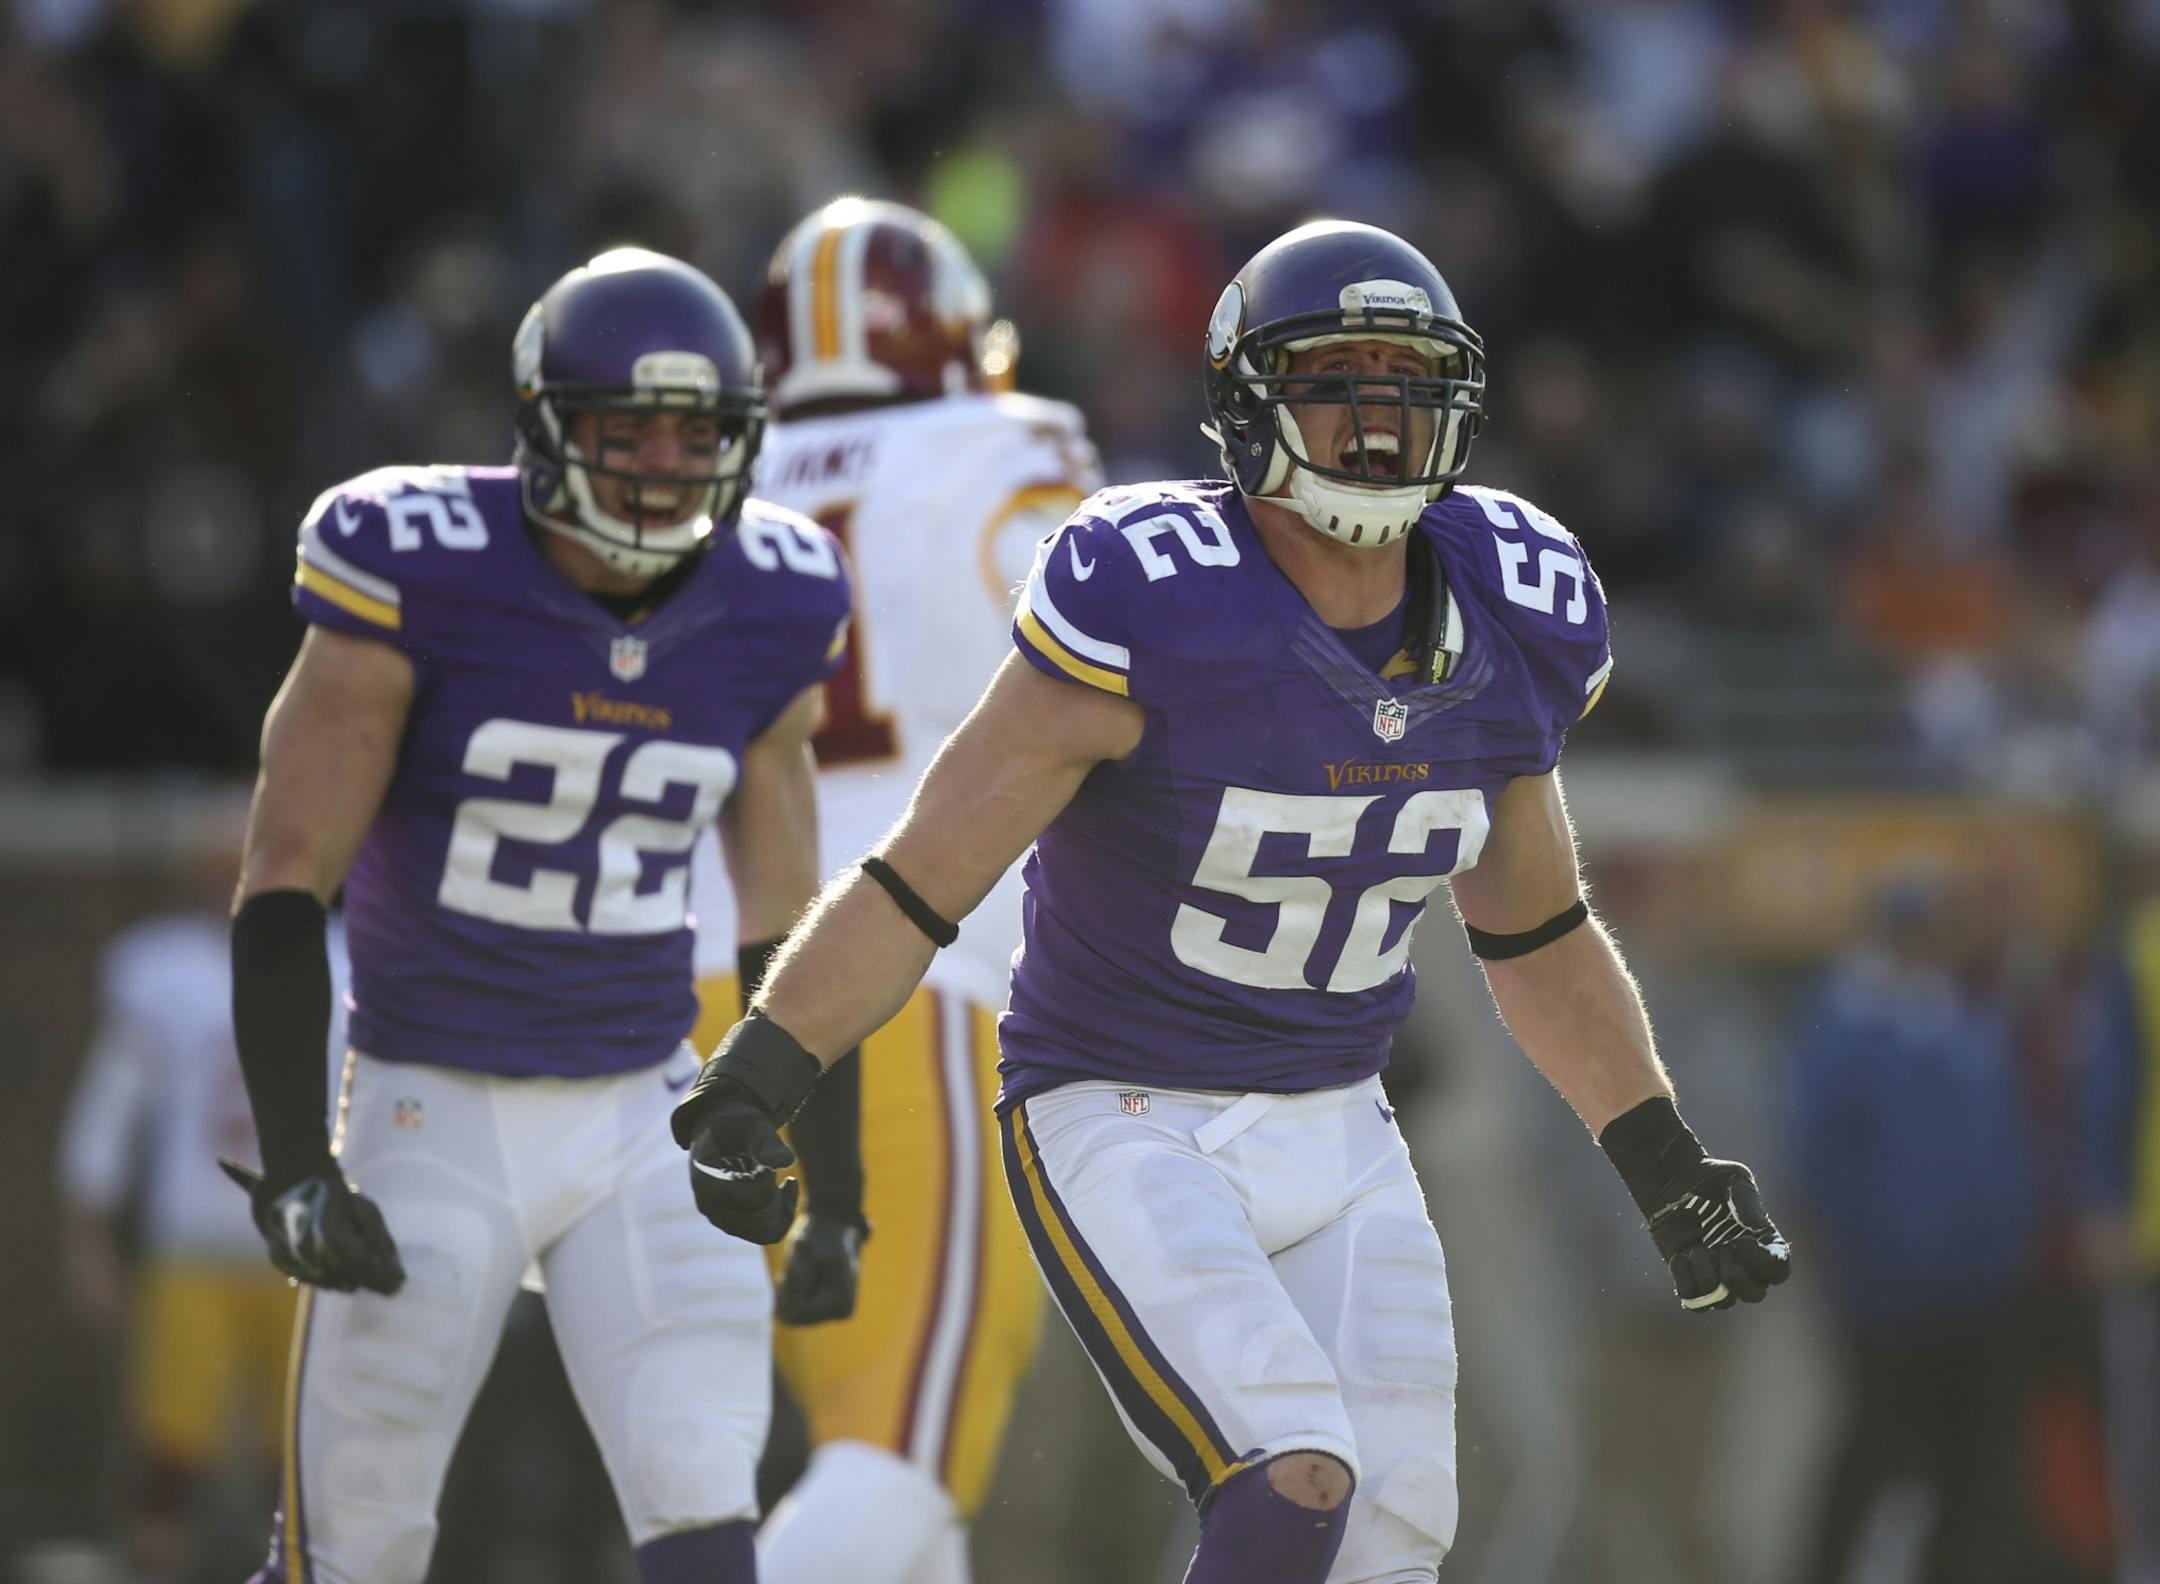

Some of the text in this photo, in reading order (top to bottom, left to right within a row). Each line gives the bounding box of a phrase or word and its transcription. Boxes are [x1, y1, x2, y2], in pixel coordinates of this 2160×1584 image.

[384, 466, 490, 551] 2
[437, 717, 738, 936] 22
[1322, 755, 1430, 791] VIKINGS
[1170, 786, 1491, 994] 52
